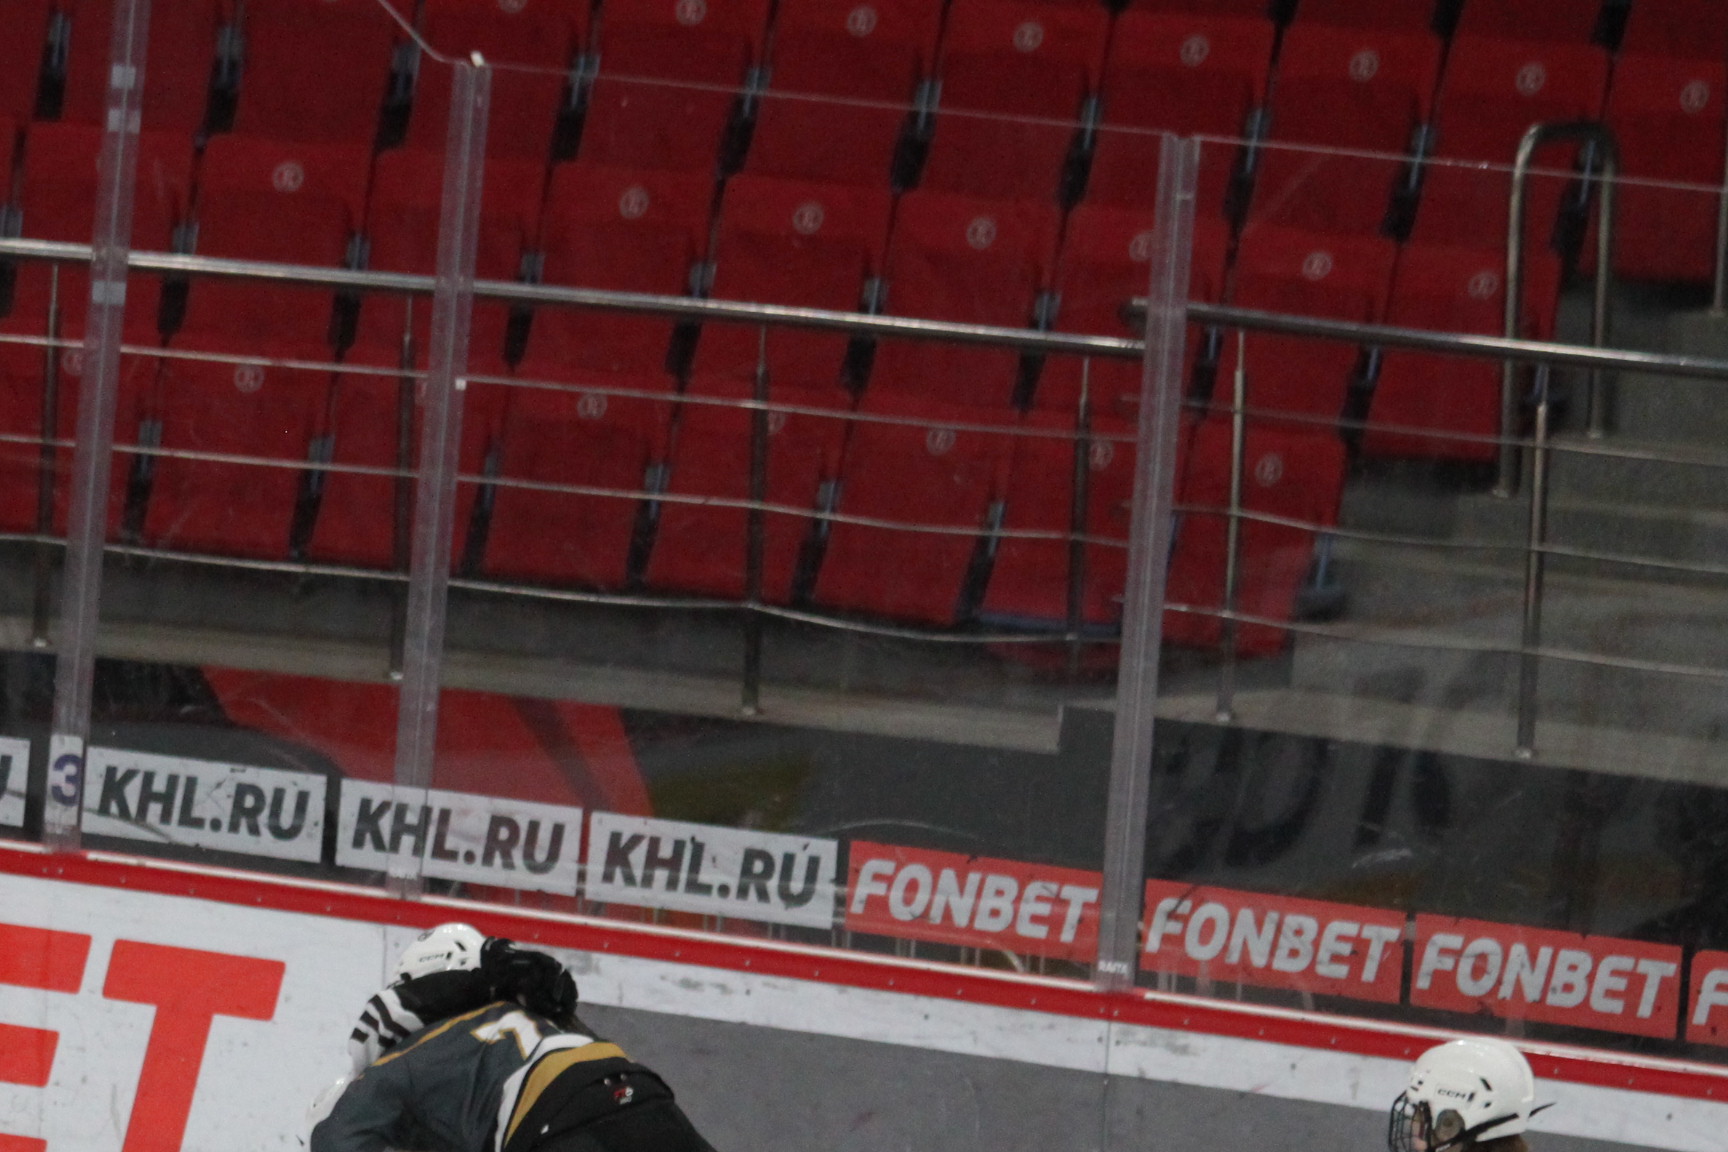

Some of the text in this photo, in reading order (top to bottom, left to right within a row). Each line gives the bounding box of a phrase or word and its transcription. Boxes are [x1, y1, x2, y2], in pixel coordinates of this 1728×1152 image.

[52, 754, 83, 807] 3
[97, 765, 311, 841] KHL.RU
[351, 797, 566, 875] KHL.RU
[601, 831, 821, 908] KHL.RU
[849, 858, 1099, 943] FONBET
[1144, 896, 1402, 983] FONBET
[1416, 932, 1677, 1019] FONBET
